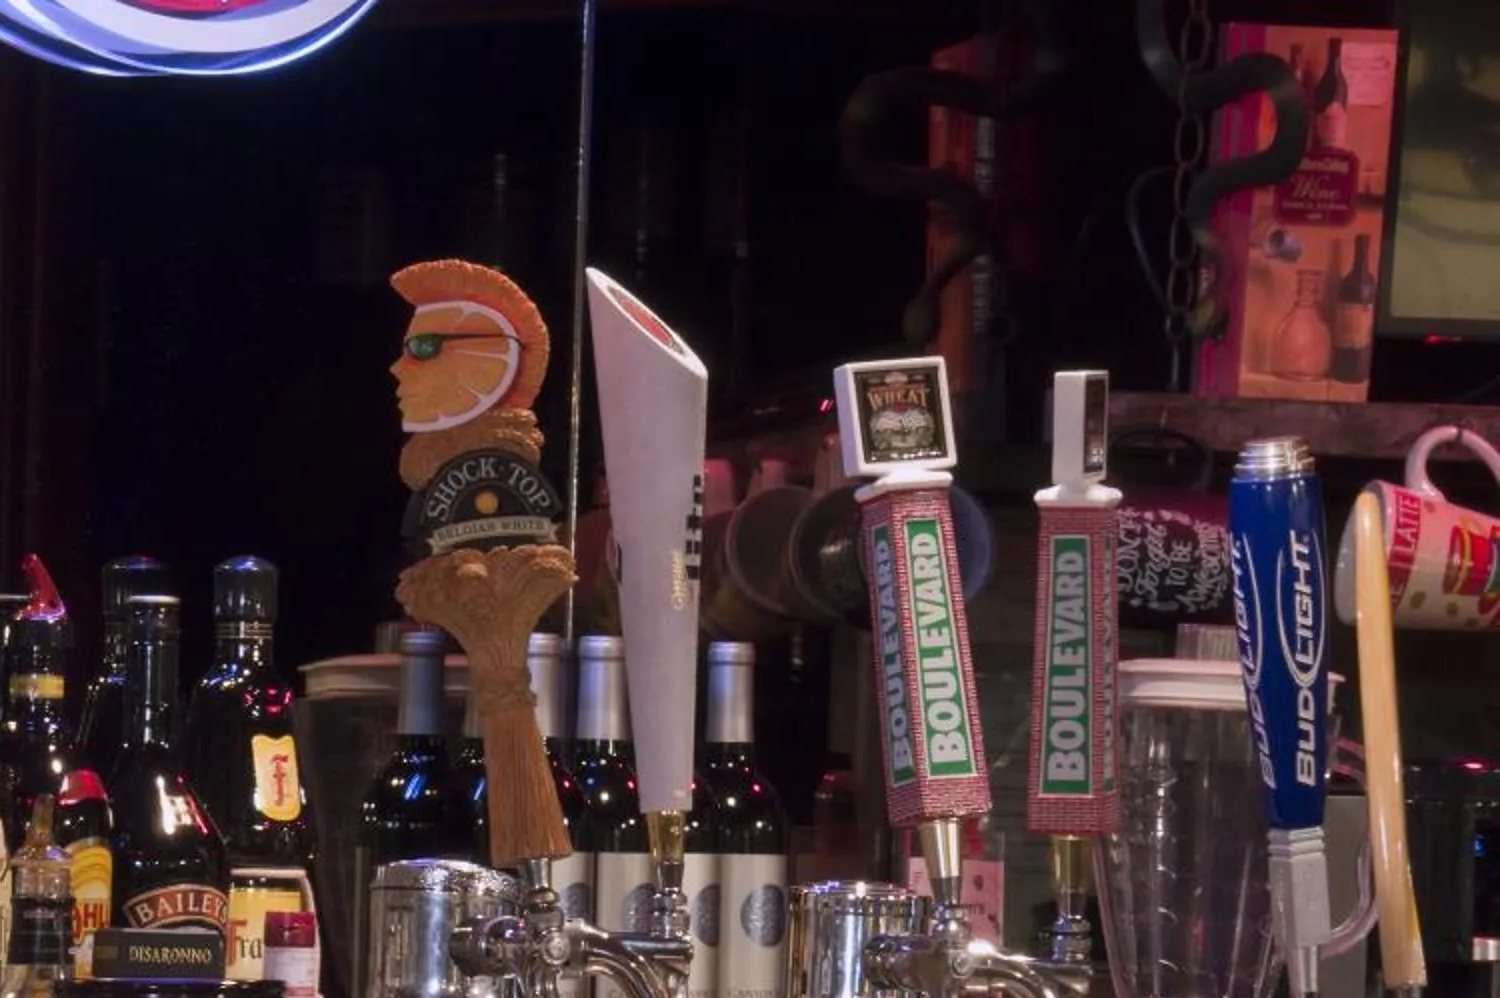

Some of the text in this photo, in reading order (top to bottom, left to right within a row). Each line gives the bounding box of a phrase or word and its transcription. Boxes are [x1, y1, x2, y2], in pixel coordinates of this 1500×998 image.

[427, 457, 551, 522] SHOCK TOP
[875, 540, 913, 769] BOULEVARD
[911, 532, 968, 763] BOULEVARD
[1047, 551, 1086, 781] BOULEVARD
[1290, 529, 1317, 787] BUD LIGHT
[128, 945, 213, 965] DISARONNO
[135, 892, 228, 925] BAILEYS
